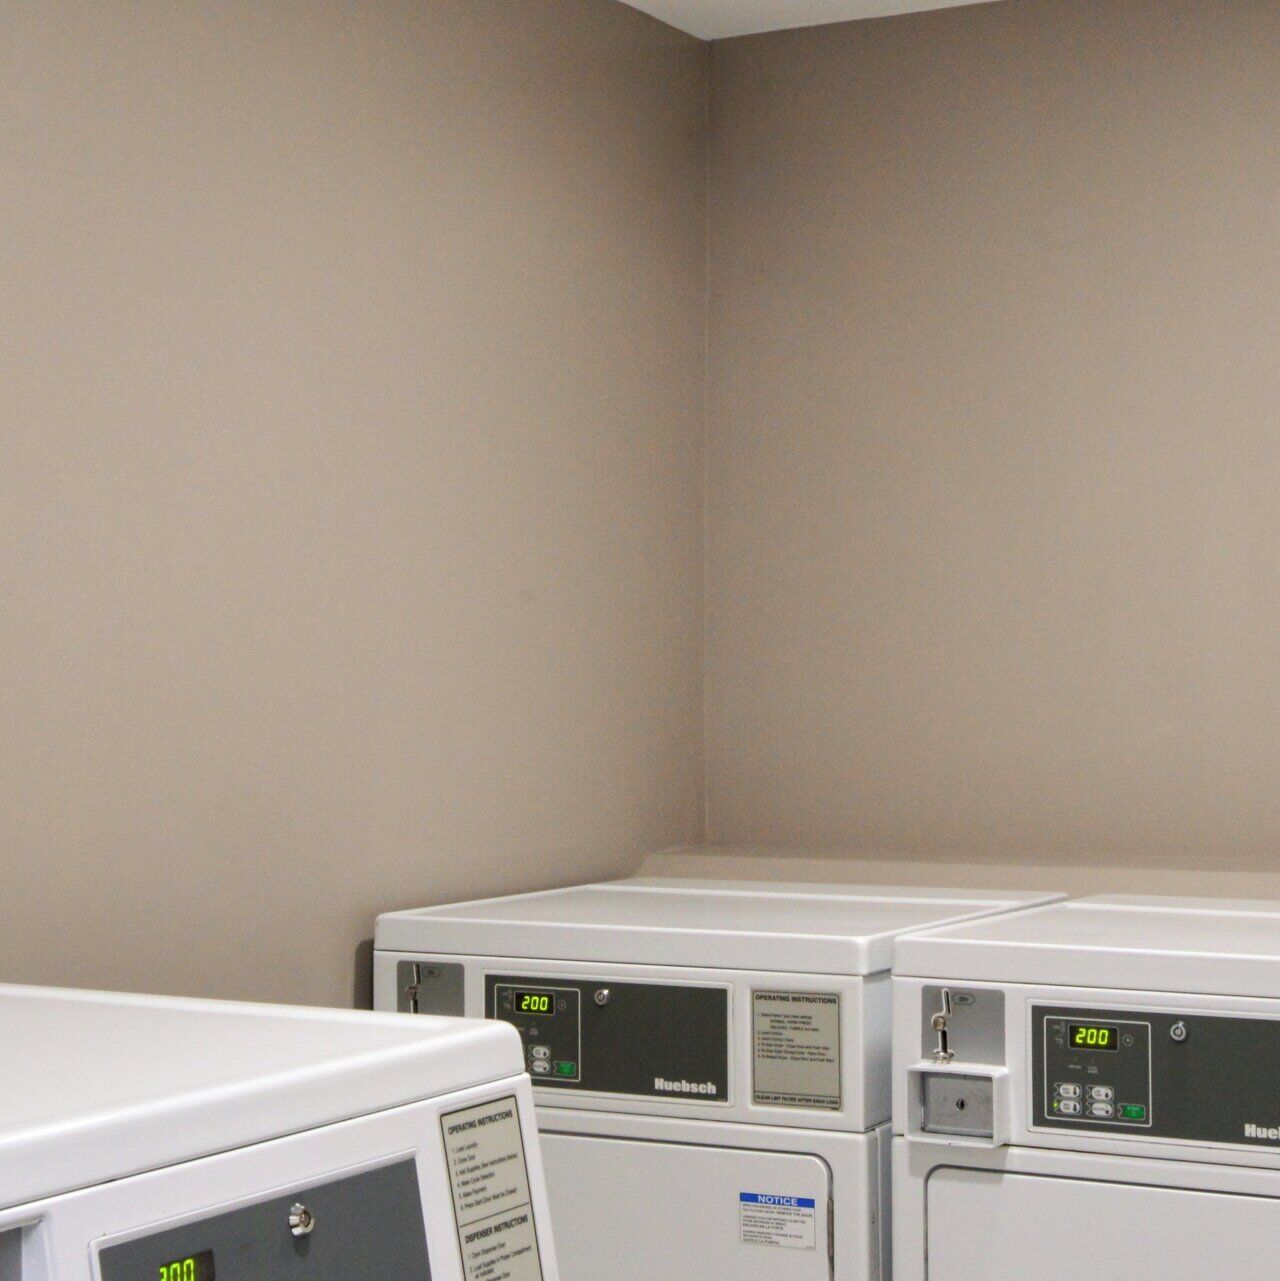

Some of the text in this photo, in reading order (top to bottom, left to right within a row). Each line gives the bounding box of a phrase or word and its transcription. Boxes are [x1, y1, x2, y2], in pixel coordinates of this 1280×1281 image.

[521, 996, 549, 1011] 200
[791, 996, 836, 1004] INSTRUCTIONS
[1075, 1028, 1109, 1045] 200
[654, 1076, 717, 1095] Huebsch
[448, 1109, 512, 1135] OPERATING INSTRUCTIONS
[757, 1195, 798, 1206] NOTICE
[464, 1213, 528, 1244] DISPENSER INSTRUCTIONS
